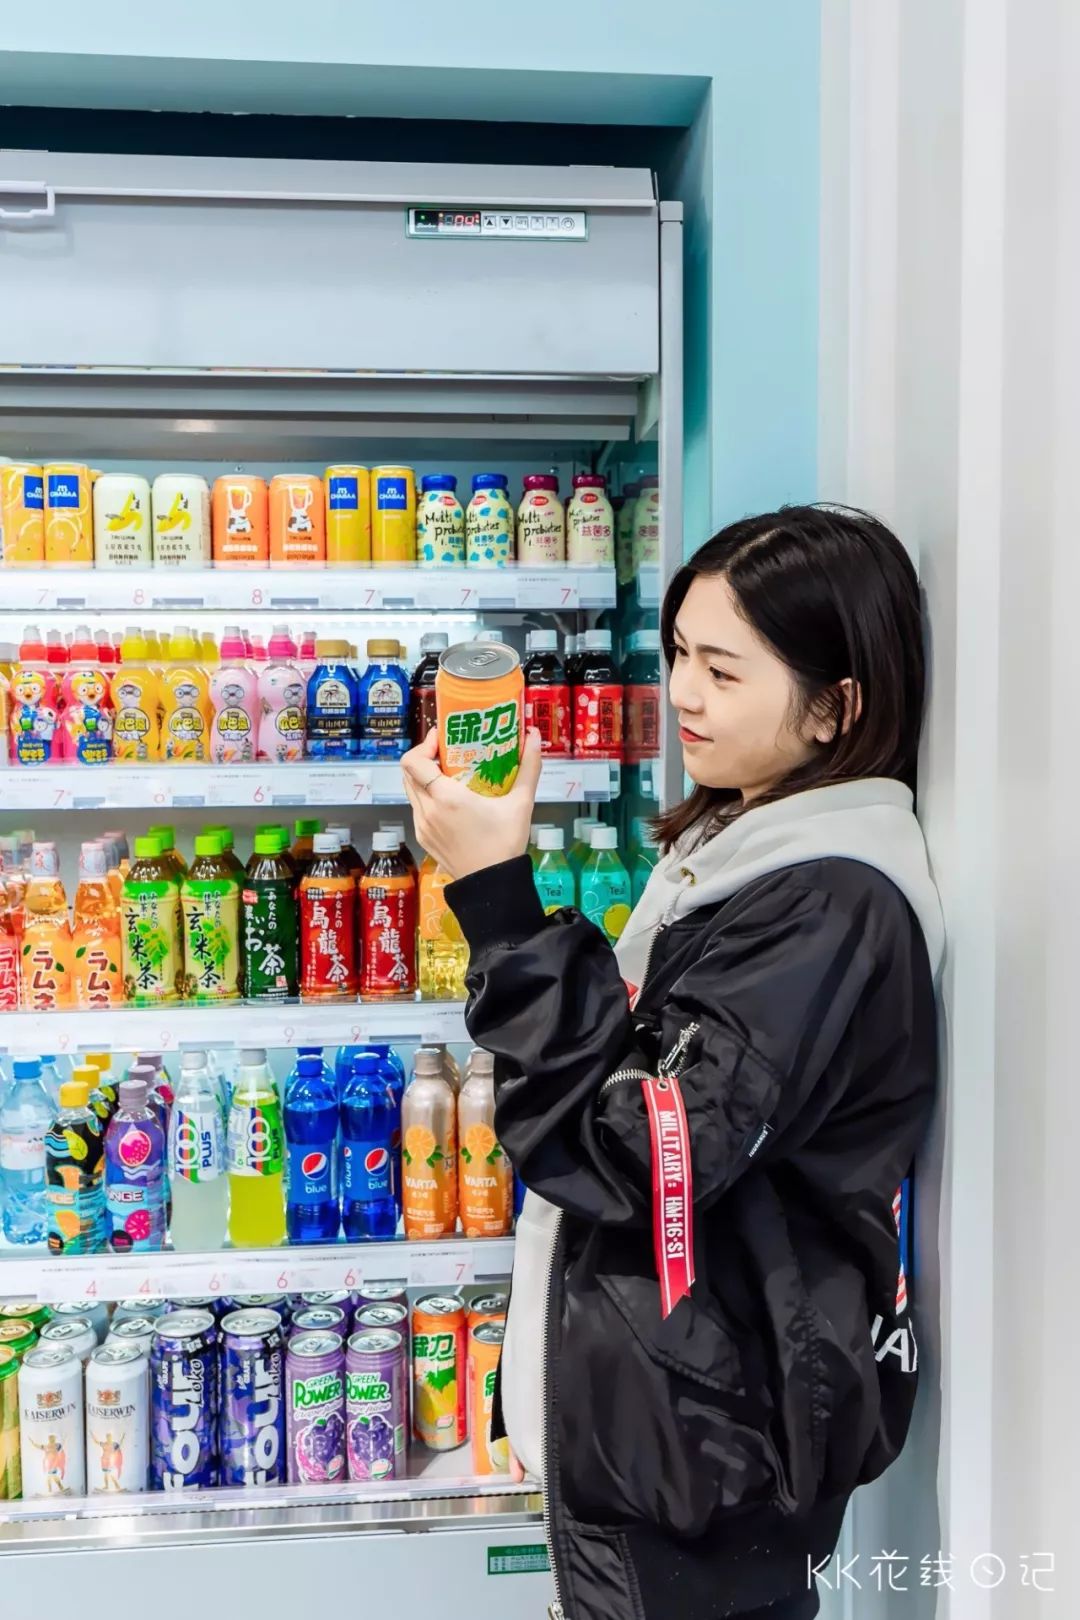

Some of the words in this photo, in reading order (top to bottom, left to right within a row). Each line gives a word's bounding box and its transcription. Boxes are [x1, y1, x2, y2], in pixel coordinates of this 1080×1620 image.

[133, 589, 144, 605] 8
[252, 589, 262, 605] 8
[364, 589, 376, 605] 7
[460, 589, 472, 605] 7
[560, 588, 572, 605] 7
[54, 790, 65, 805] 7
[253, 785, 264, 802] 6
[353, 784, 364, 800] 7
[566, 782, 576, 797] 7
[546, 888, 561, 897] Tea
[610, 887, 625, 895] Tea
[125, 907, 158, 990] 玄米茶
[186, 906, 220, 988] 玄米茶
[351, 1026, 361, 1042] 9
[201, 1131, 213, 1168] PLUS
[659, 1110, 683, 1188] MILITARY:
[305, 1182, 327, 1194] blue
[368, 1179, 388, 1190] blue
[277, 1272, 287, 1288] 6
[344, 1268, 355, 1286] 6
[456, 1264, 465, 1280] 7
[86, 1280, 97, 1296] 4
[139, 1280, 150, 1294] 4
[209, 1274, 219, 1291] 6
[186, 1359, 205, 1407] Loko
[268, 1353, 281, 1400] Loko
[295, 1381, 341, 1408] POWER
